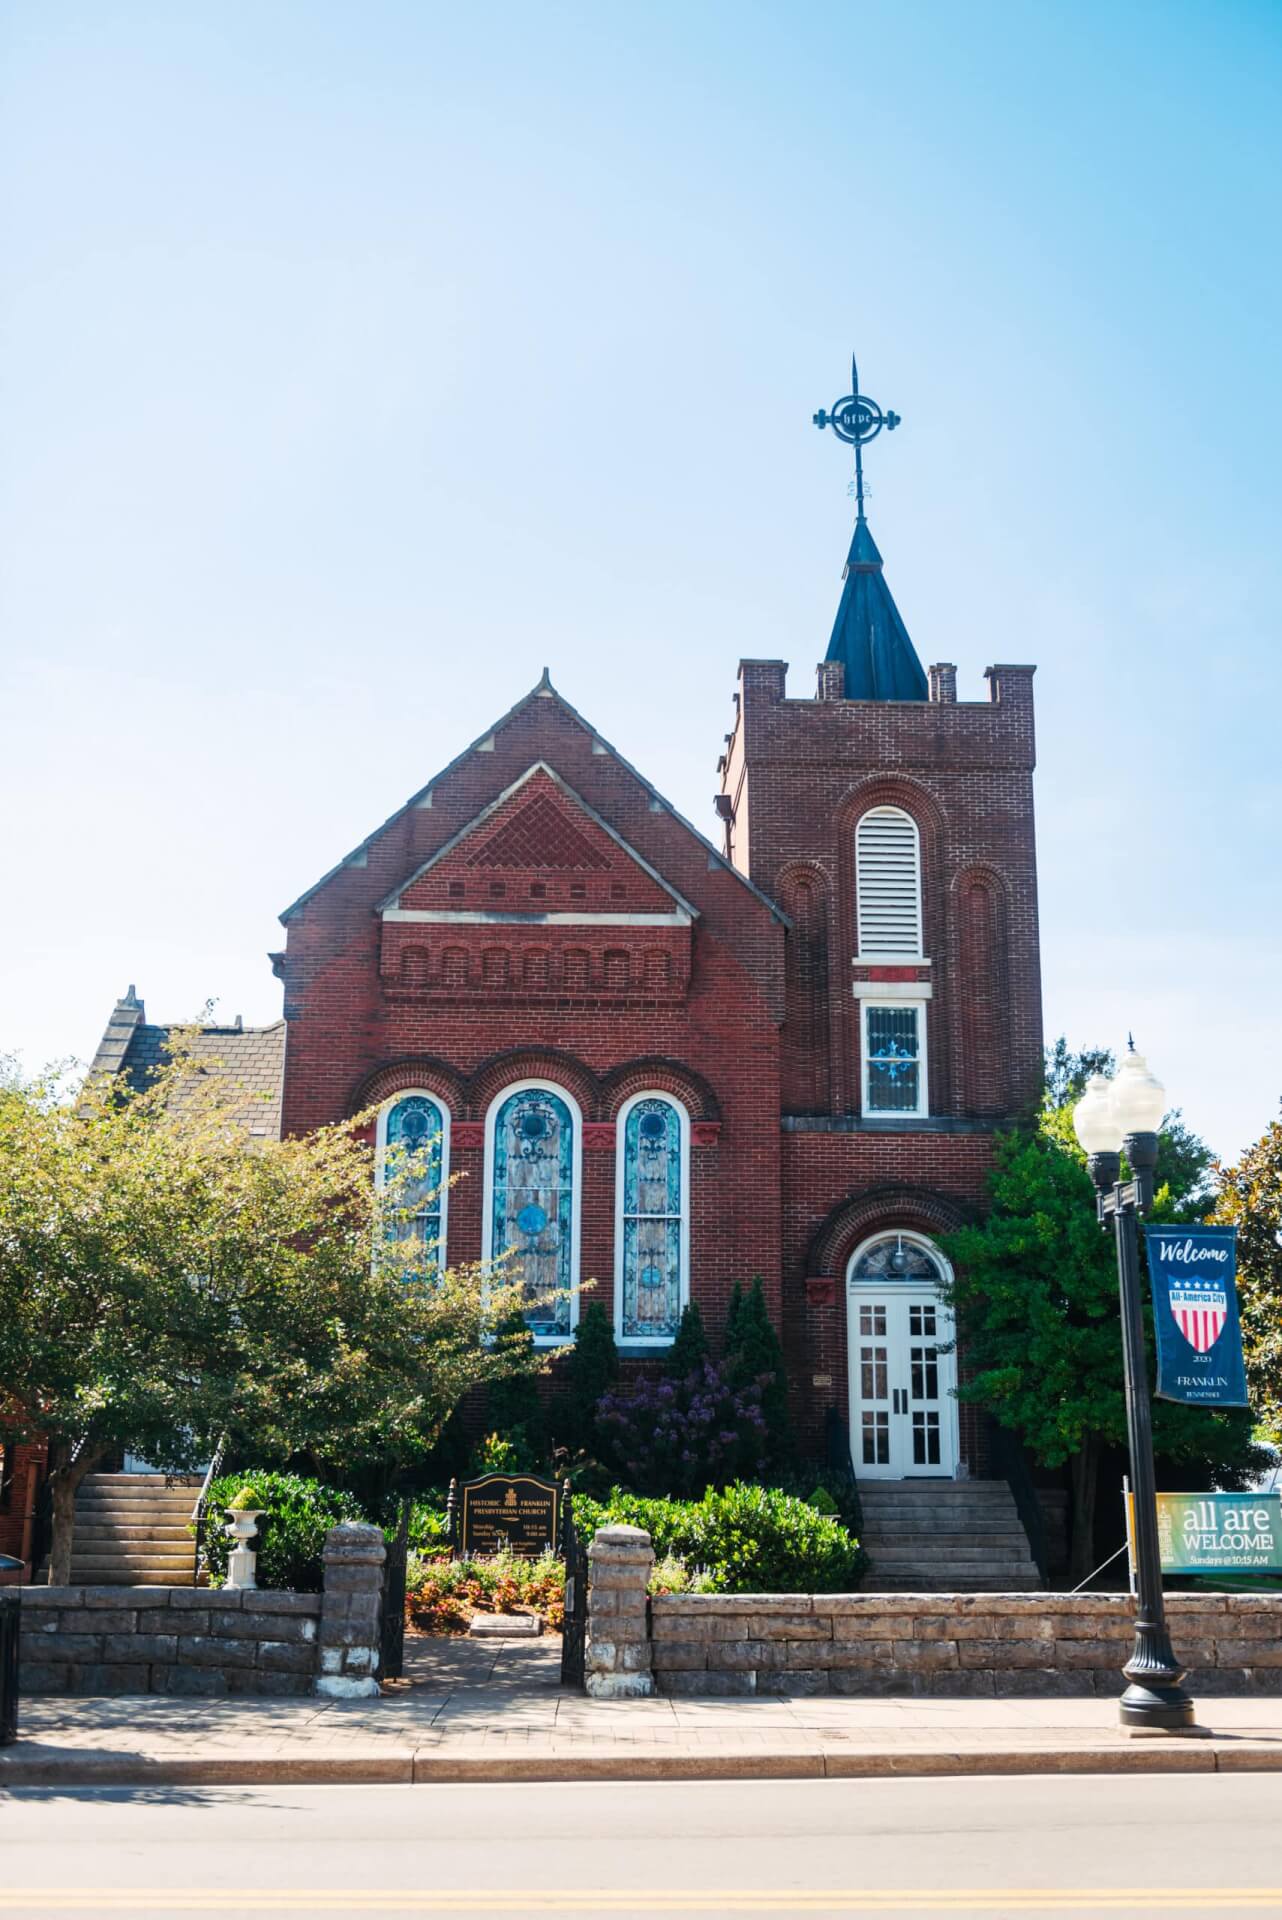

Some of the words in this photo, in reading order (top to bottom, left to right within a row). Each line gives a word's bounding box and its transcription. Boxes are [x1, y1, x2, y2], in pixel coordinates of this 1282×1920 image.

[1159, 1239, 1229, 1264] Welcome
[1171, 1291, 1212, 1303] All-America
[1212, 1293, 1225, 1305] City
[1177, 1376, 1229, 1387] FRANKLIN
[1183, 1501, 1219, 1531] all
[1223, 1509, 1270, 1531] are
[1183, 1533, 1274, 1551] WELCOME!
[1190, 1555, 1223, 1566] Sundays
[1232, 1555, 1252, 1565] 10:15
[1252, 1555, 1269, 1565] AM
